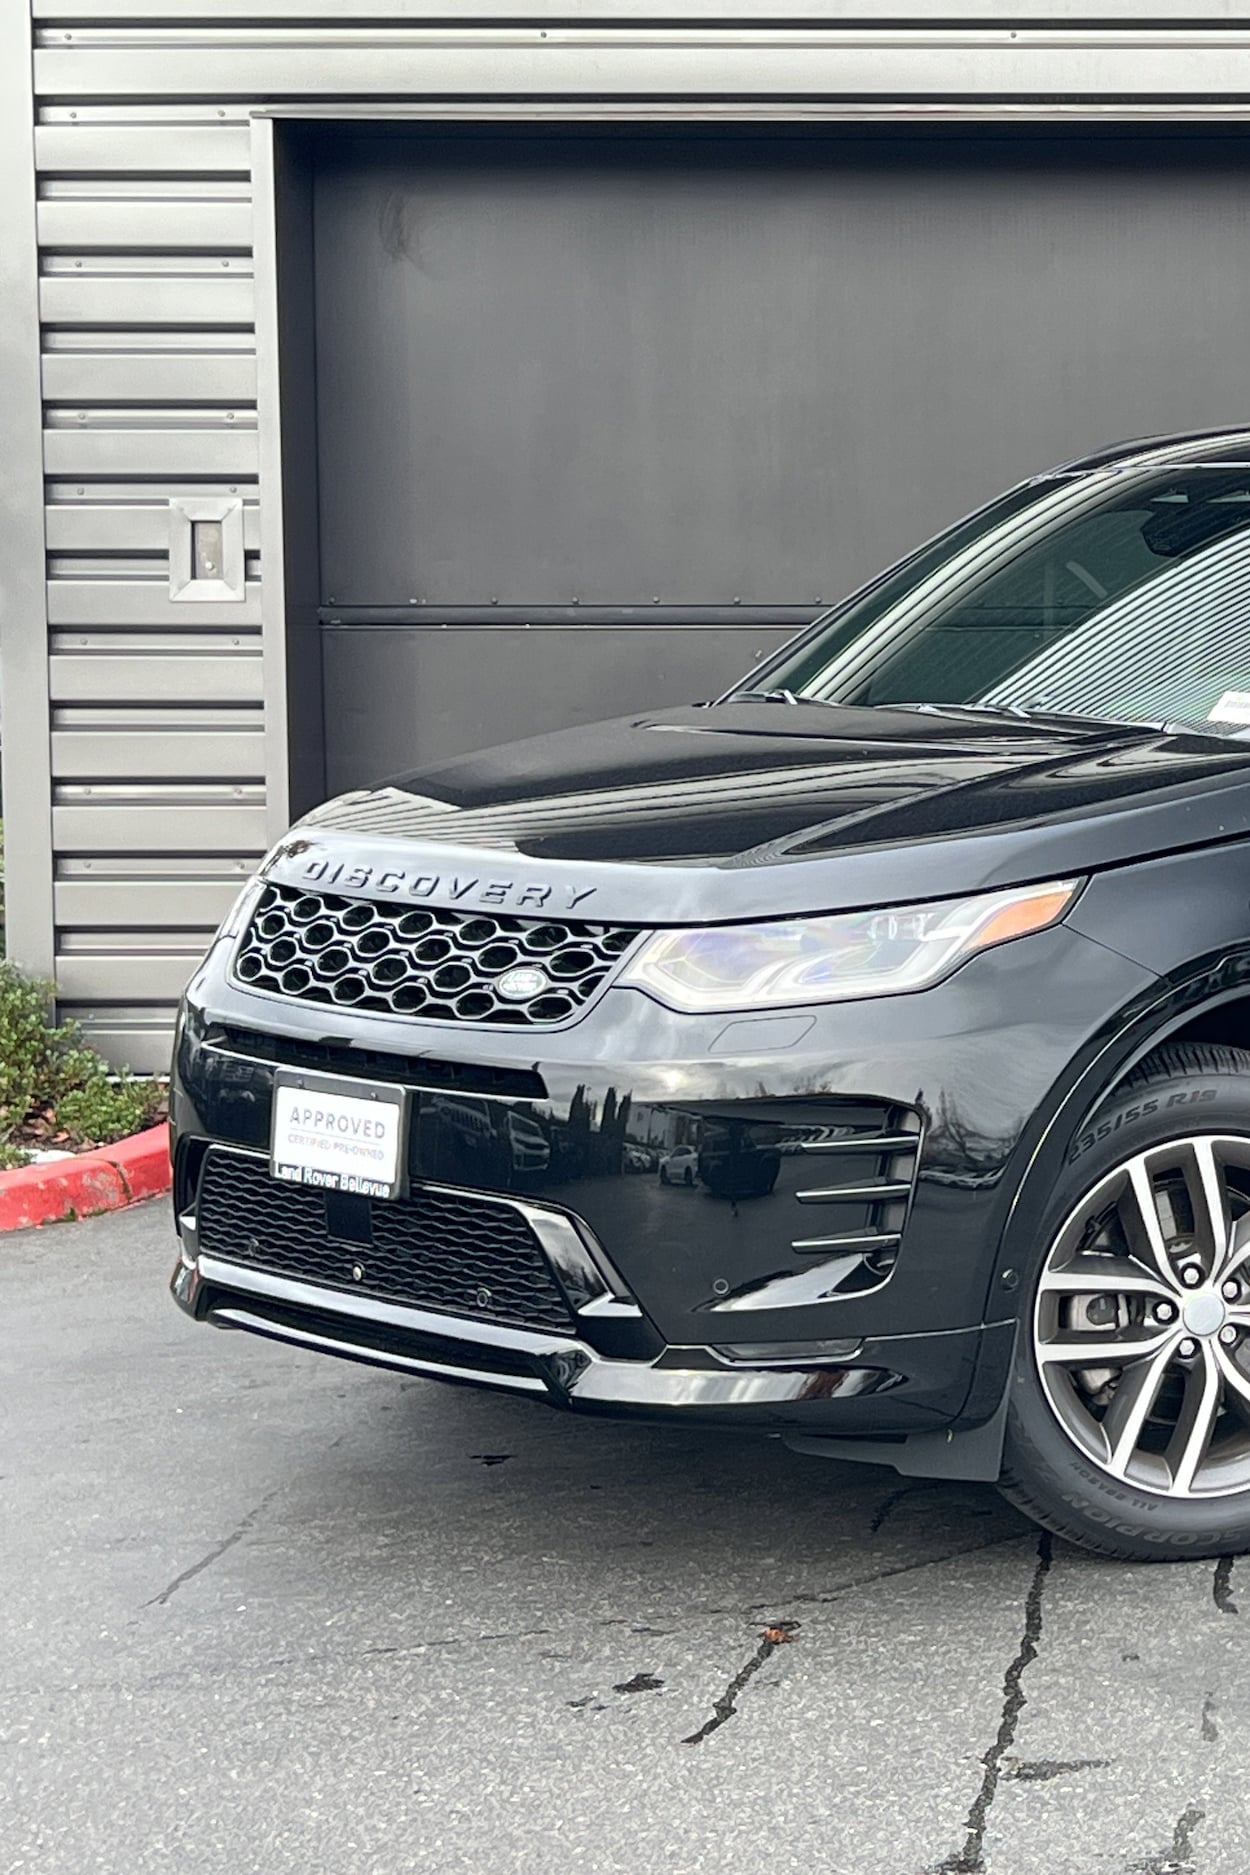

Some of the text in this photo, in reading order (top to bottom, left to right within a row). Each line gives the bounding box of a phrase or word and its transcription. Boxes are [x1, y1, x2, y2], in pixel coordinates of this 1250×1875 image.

[302, 861, 597, 909] DISCOVERY
[290, 1107, 385, 1138] APPROVED
[1067, 1099, 1159, 1166] 235/55
[274, 1162, 391, 1198] Land Rover Bellevue
[1061, 1492, 1248, 1546] SCORPION
